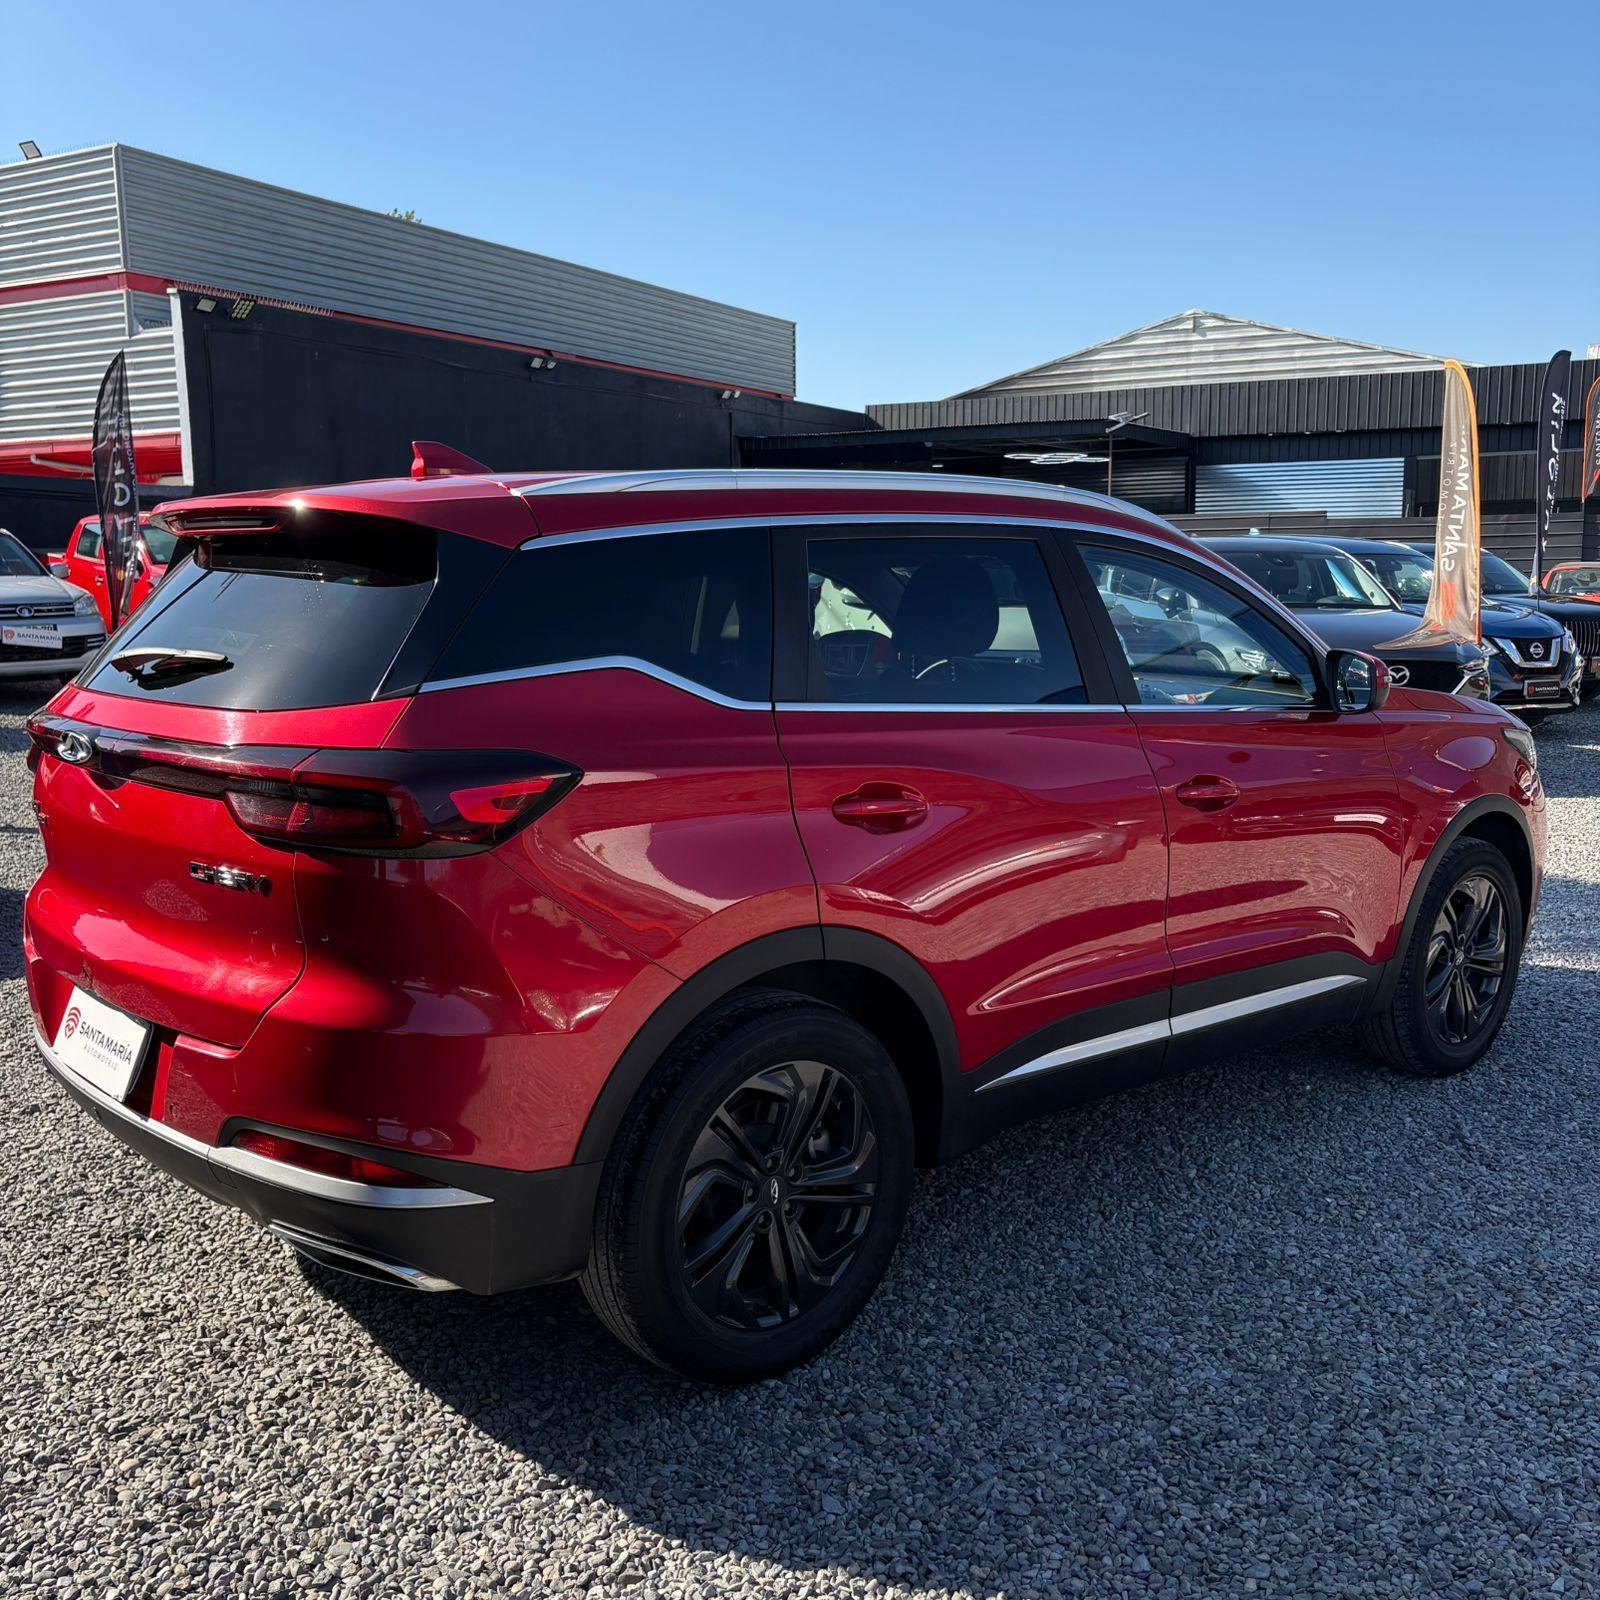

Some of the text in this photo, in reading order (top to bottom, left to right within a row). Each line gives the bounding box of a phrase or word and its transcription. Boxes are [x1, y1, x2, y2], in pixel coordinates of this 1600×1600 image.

[189, 861, 268, 894] CHERY
[79, 1021, 133, 1065] SANTAMARÍA
[84, 1044, 119, 1071] AUTOMOTRIZ
